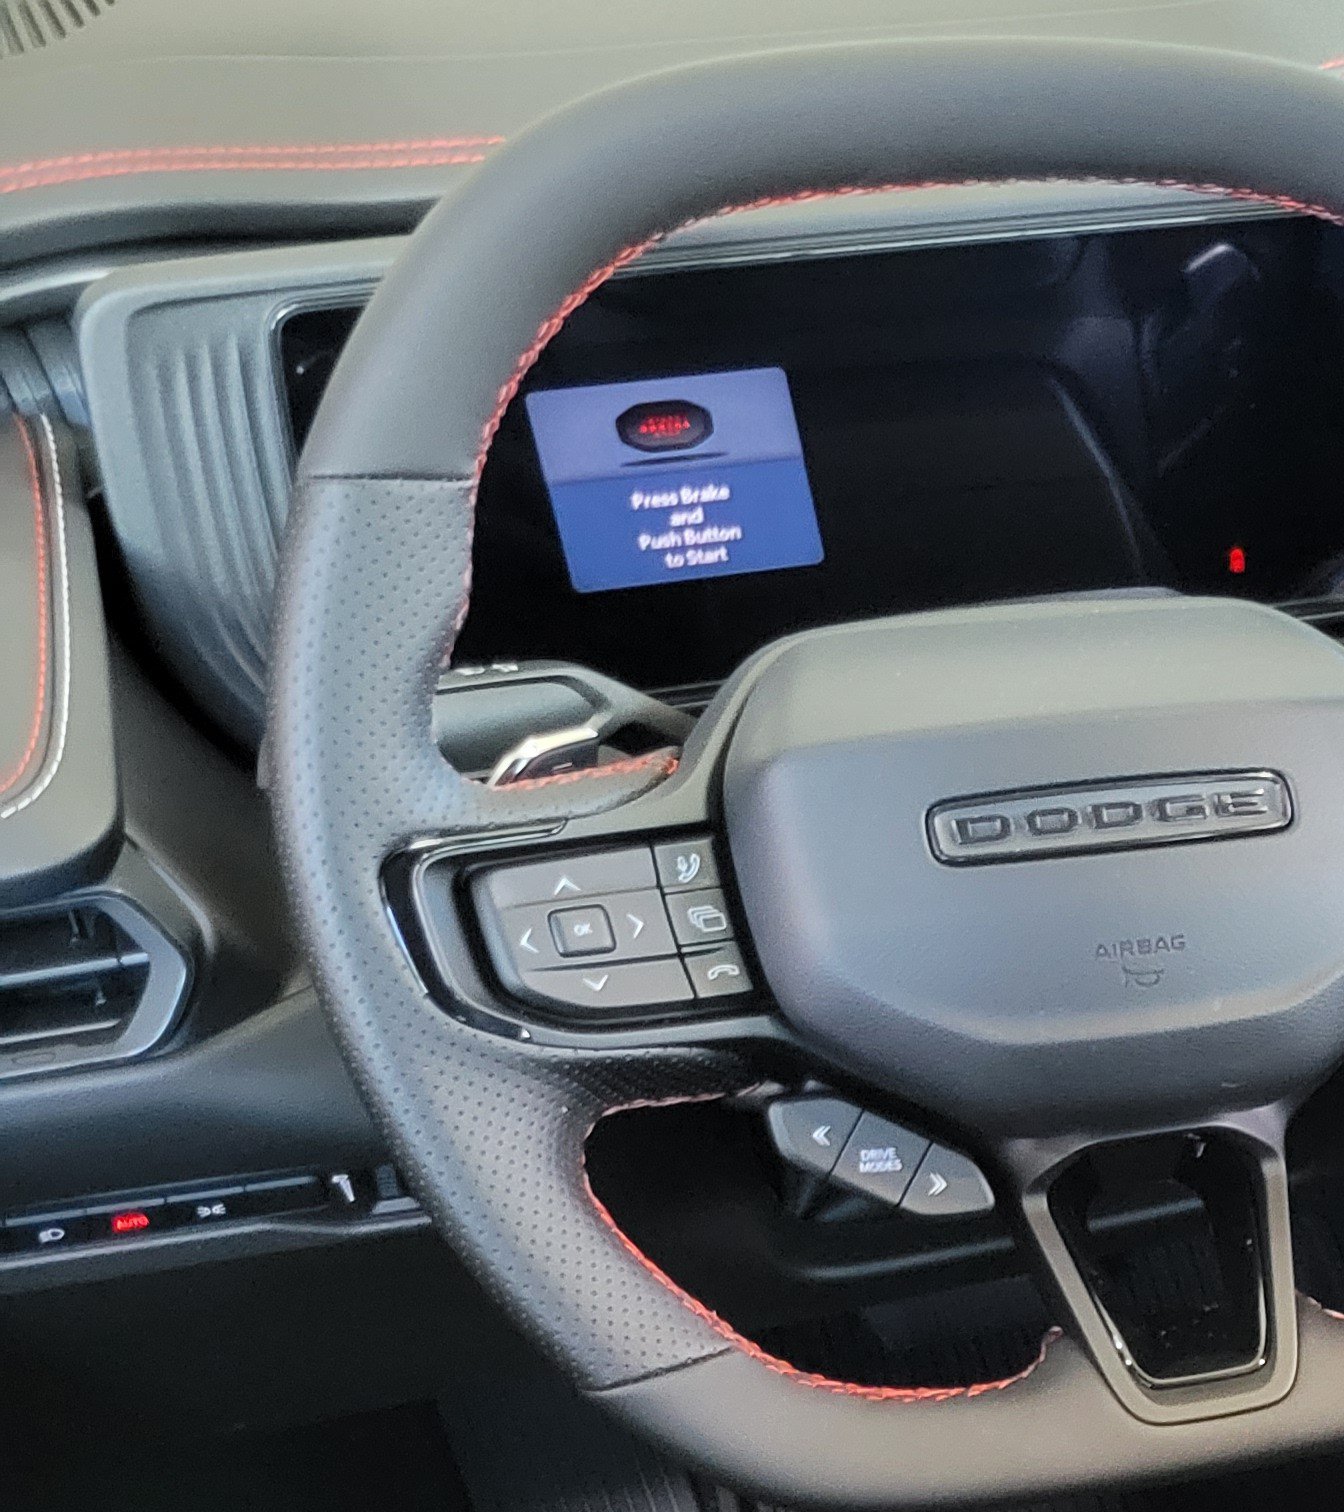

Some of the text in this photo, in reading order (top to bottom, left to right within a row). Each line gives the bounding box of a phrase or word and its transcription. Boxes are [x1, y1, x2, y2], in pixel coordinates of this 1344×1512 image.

[630, 483, 731, 511] Press Brake
[669, 506, 705, 526] and
[637, 525, 742, 551] Push Button
[664, 546, 729, 568] to Start
[951, 787, 1267, 846] DODGE
[573, 921, 593, 937] OK
[1095, 932, 1187, 962] AIRBAG
[860, 1147, 898, 1161] DRIVE
[115, 1211, 151, 1232] AUTO
